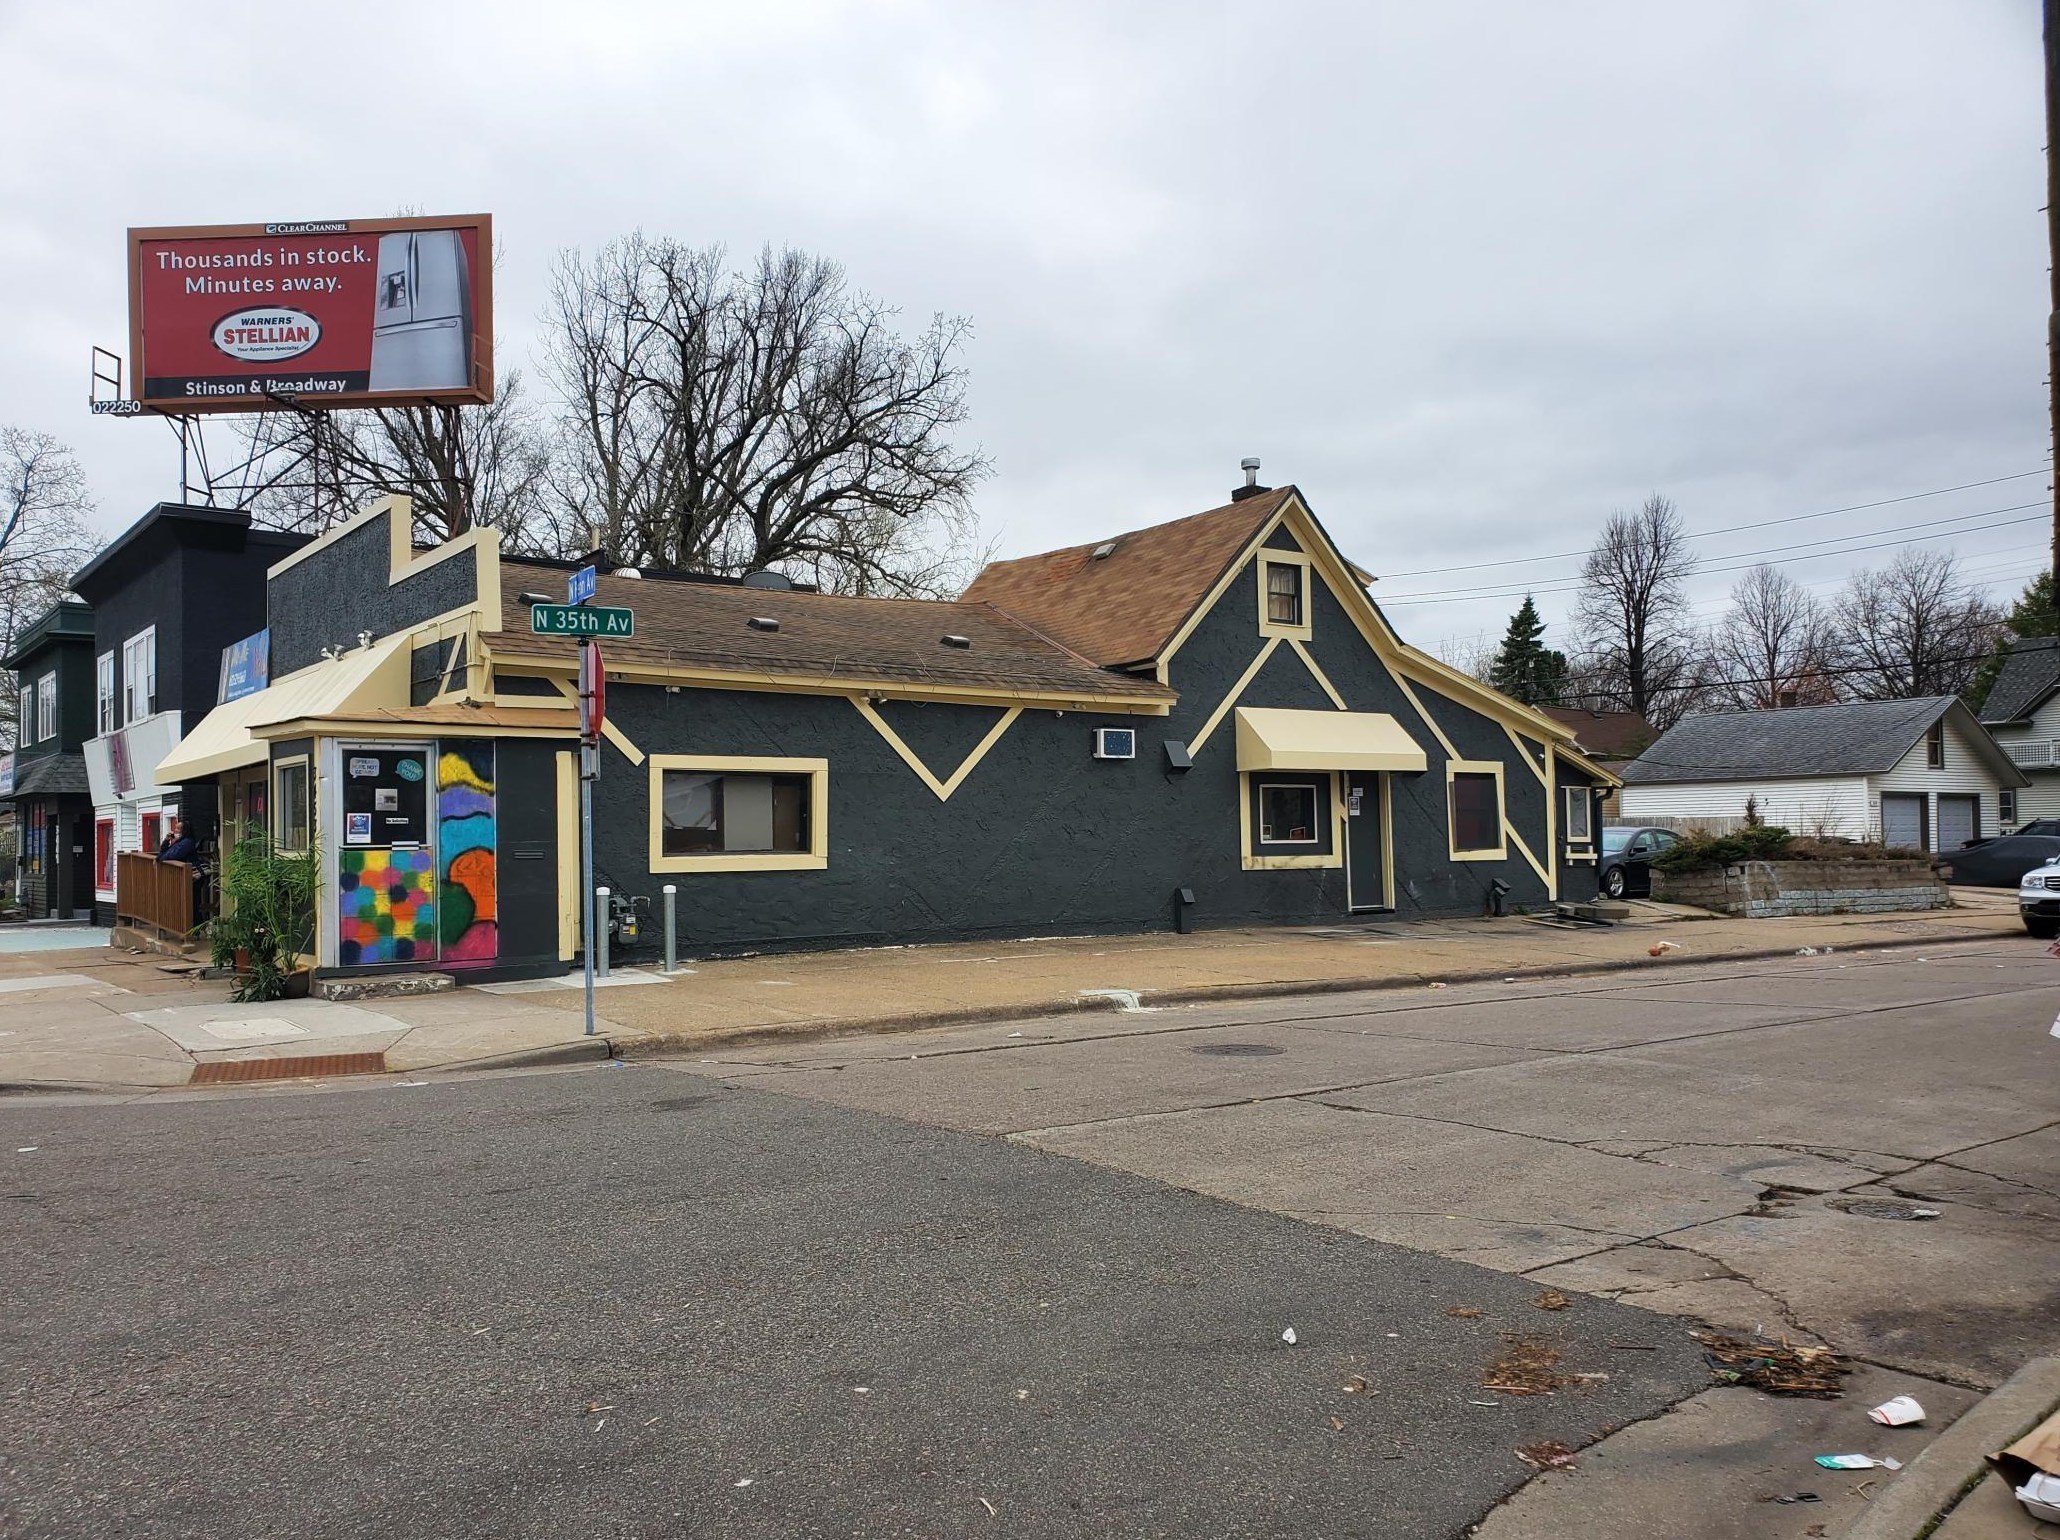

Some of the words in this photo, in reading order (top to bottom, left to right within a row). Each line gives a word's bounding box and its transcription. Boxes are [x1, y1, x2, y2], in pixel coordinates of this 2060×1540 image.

[156, 247, 273, 270] Thousands
[279, 247, 299, 266] in
[306, 244, 371, 265] stock.
[184, 274, 275, 295] Minutes
[281, 276, 342, 296] away.
[223, 326, 310, 345] STELLIAN
[185, 380, 247, 396] Stinson
[250, 380, 262, 394] &
[266, 377, 346, 395] Broadway
[93, 400, 141, 414] 022250
[587, 573, 593, 592] Av
[536, 611, 548, 628] N
[556, 611, 598, 631] 35th
[606, 614, 629, 632] Av
